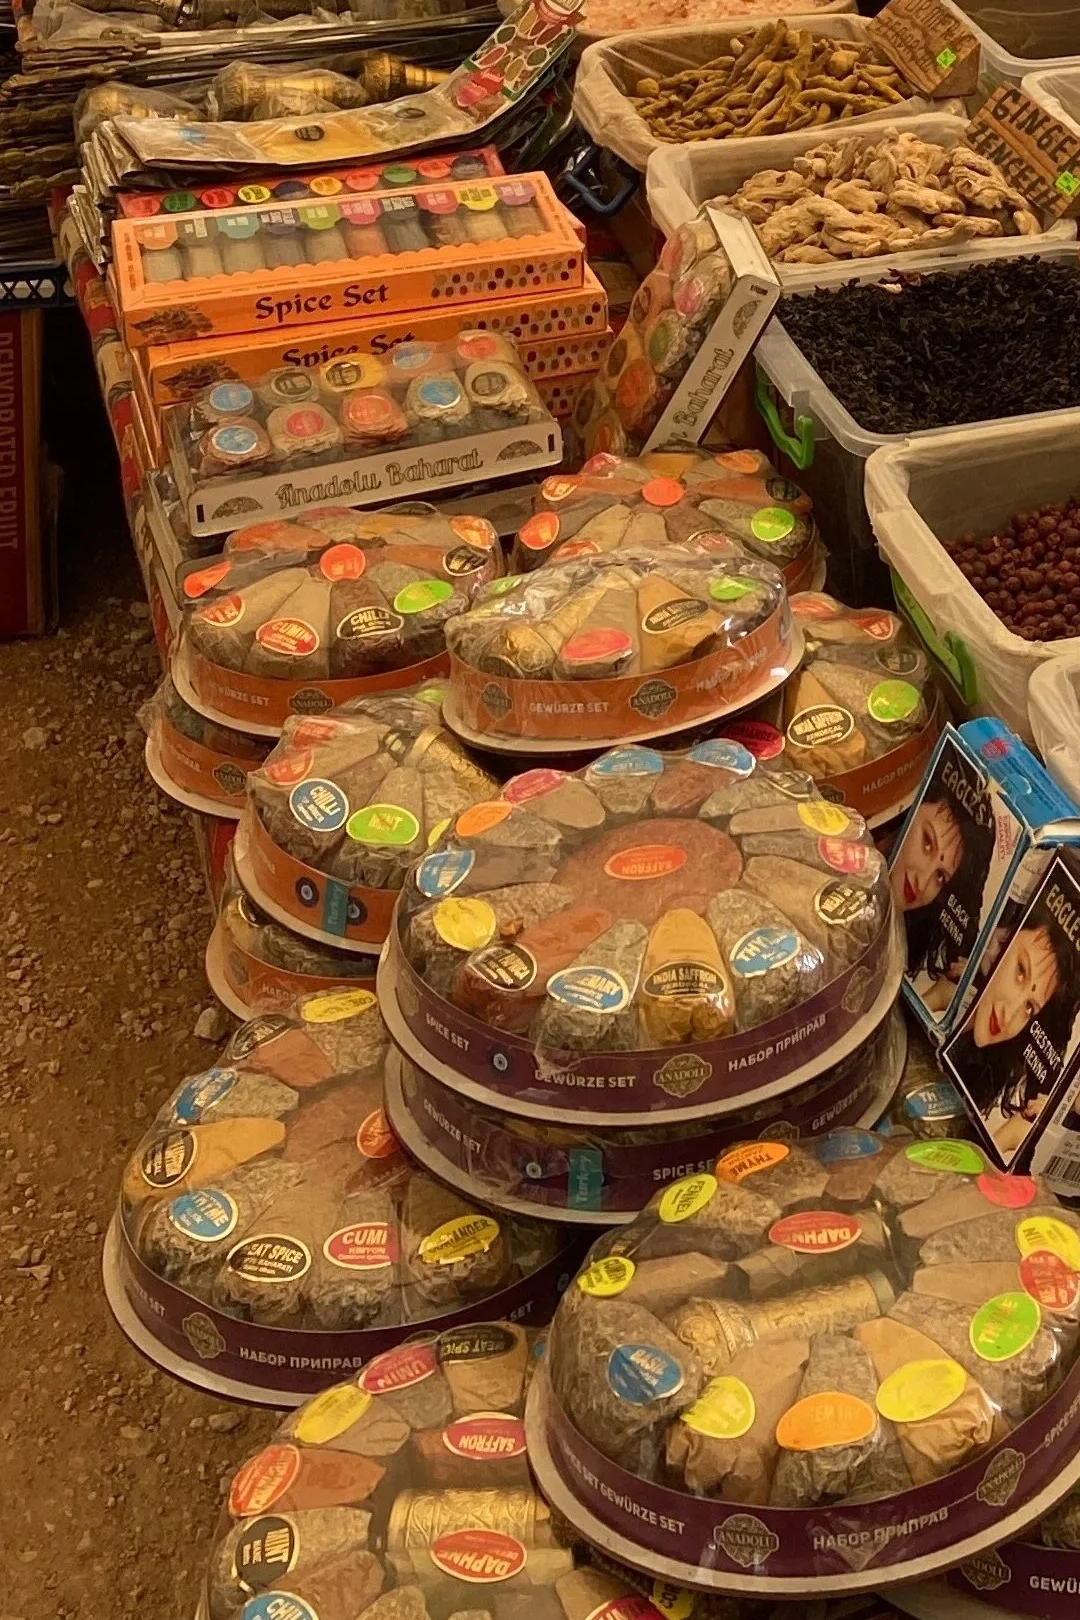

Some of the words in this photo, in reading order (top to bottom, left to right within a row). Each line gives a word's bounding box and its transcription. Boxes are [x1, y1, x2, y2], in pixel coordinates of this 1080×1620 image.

[254, 287, 333, 321] Spice
[340, 283, 391, 308] Set
[689, 346, 735, 437] Baharat
[274, 471, 383, 511] Anadolu
[387, 447, 484, 488] Baharat
[270, 620, 314, 643] CUMIN
[652, 969, 679, 984] INDIA
[678, 968, 719, 985] SAFFRON
[449, 1032, 471, 1053] SET
[727, 1044, 774, 1073] НАБОР
[776, 1013, 829, 1055] ПРИПРАВ
[1029, 1019, 1063, 1071] CHESTNUT
[1022, 1042, 1048, 1085] HENNA
[607, 1075, 636, 1089] SET
[270, 1244, 304, 1264] SPICE
[239, 1346, 287, 1367] НАБОР
[289, 1355, 362, 1370] ПРИПРАВ
[458, 1434, 516, 1453] SAFFRON
[658, 1515, 685, 1536] SET
[812, 1526, 868, 1551] НАБОР
[872, 1507, 949, 1543] ПРИПРАВ
